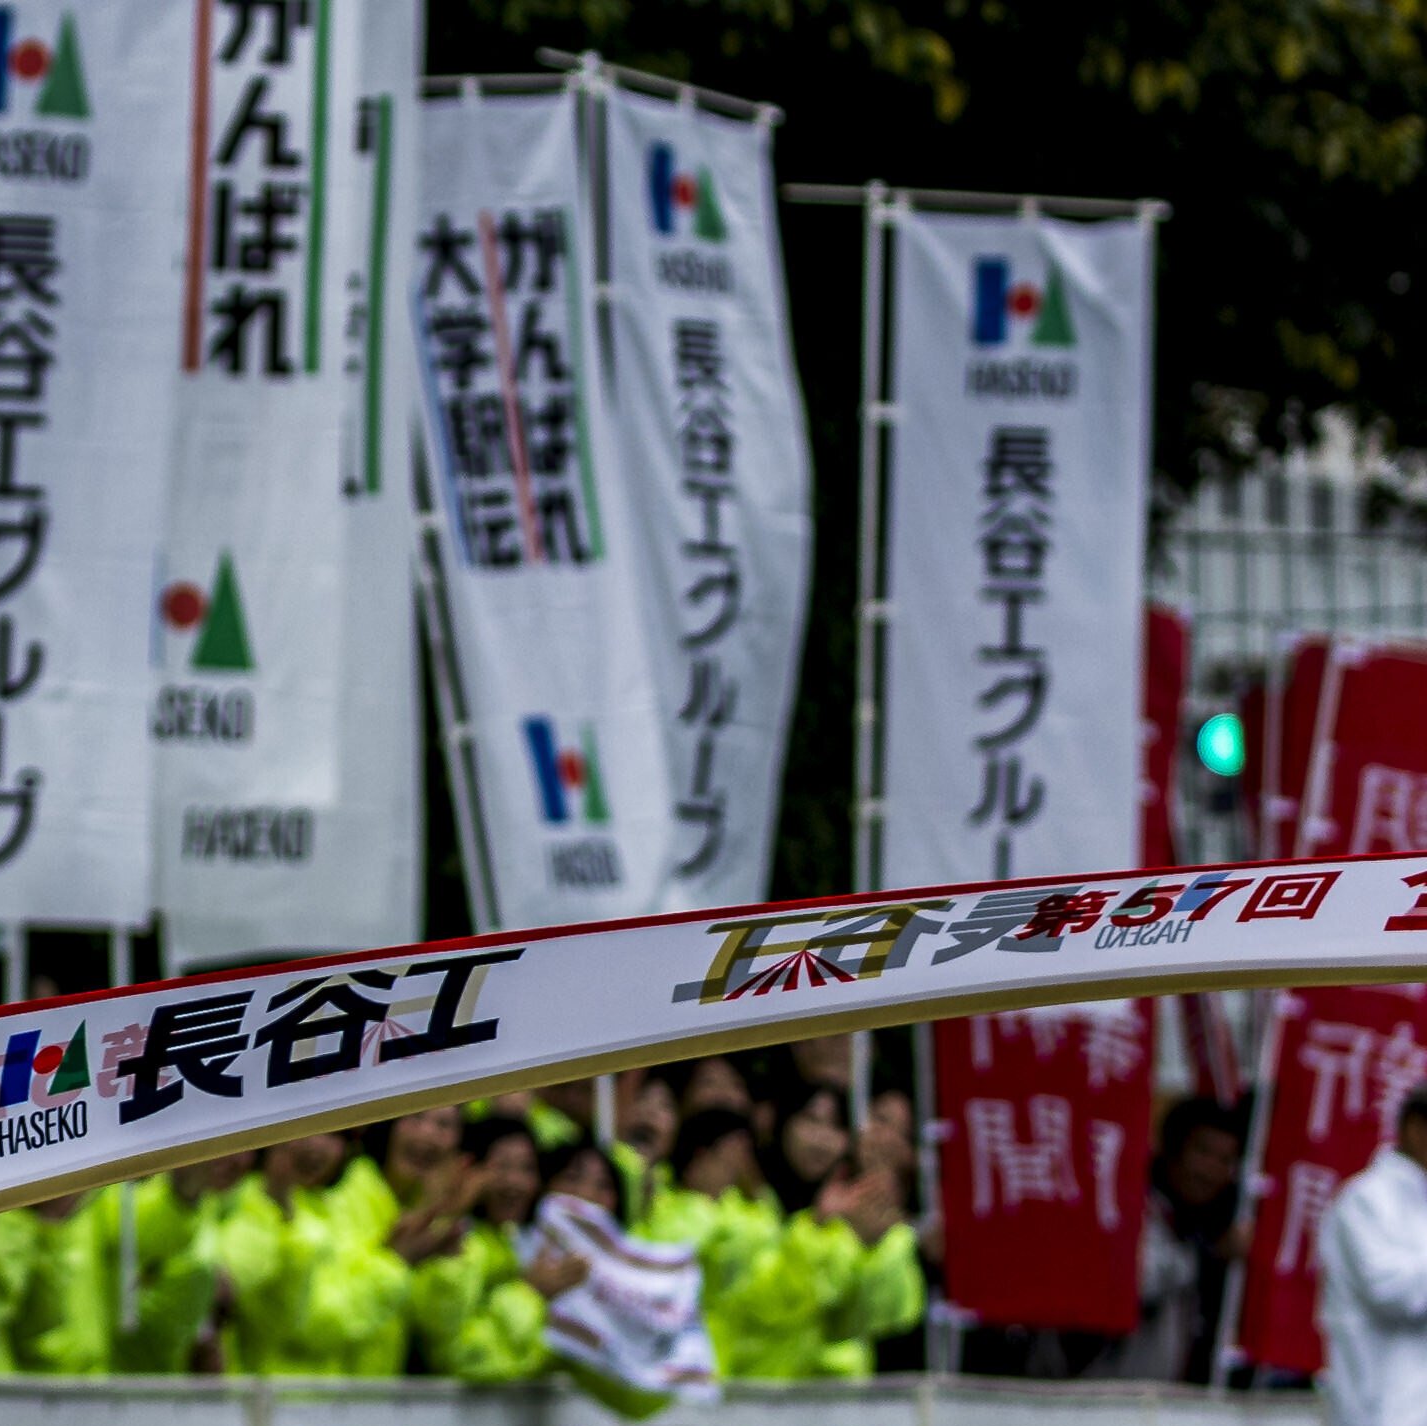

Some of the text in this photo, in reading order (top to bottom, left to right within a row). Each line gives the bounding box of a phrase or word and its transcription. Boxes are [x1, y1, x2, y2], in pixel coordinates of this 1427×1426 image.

[152, 686, 255, 742] SEKO
[970, 424, 1054, 881] 長谷工グルー
[117, 947, 526, 1125] 長谷工
